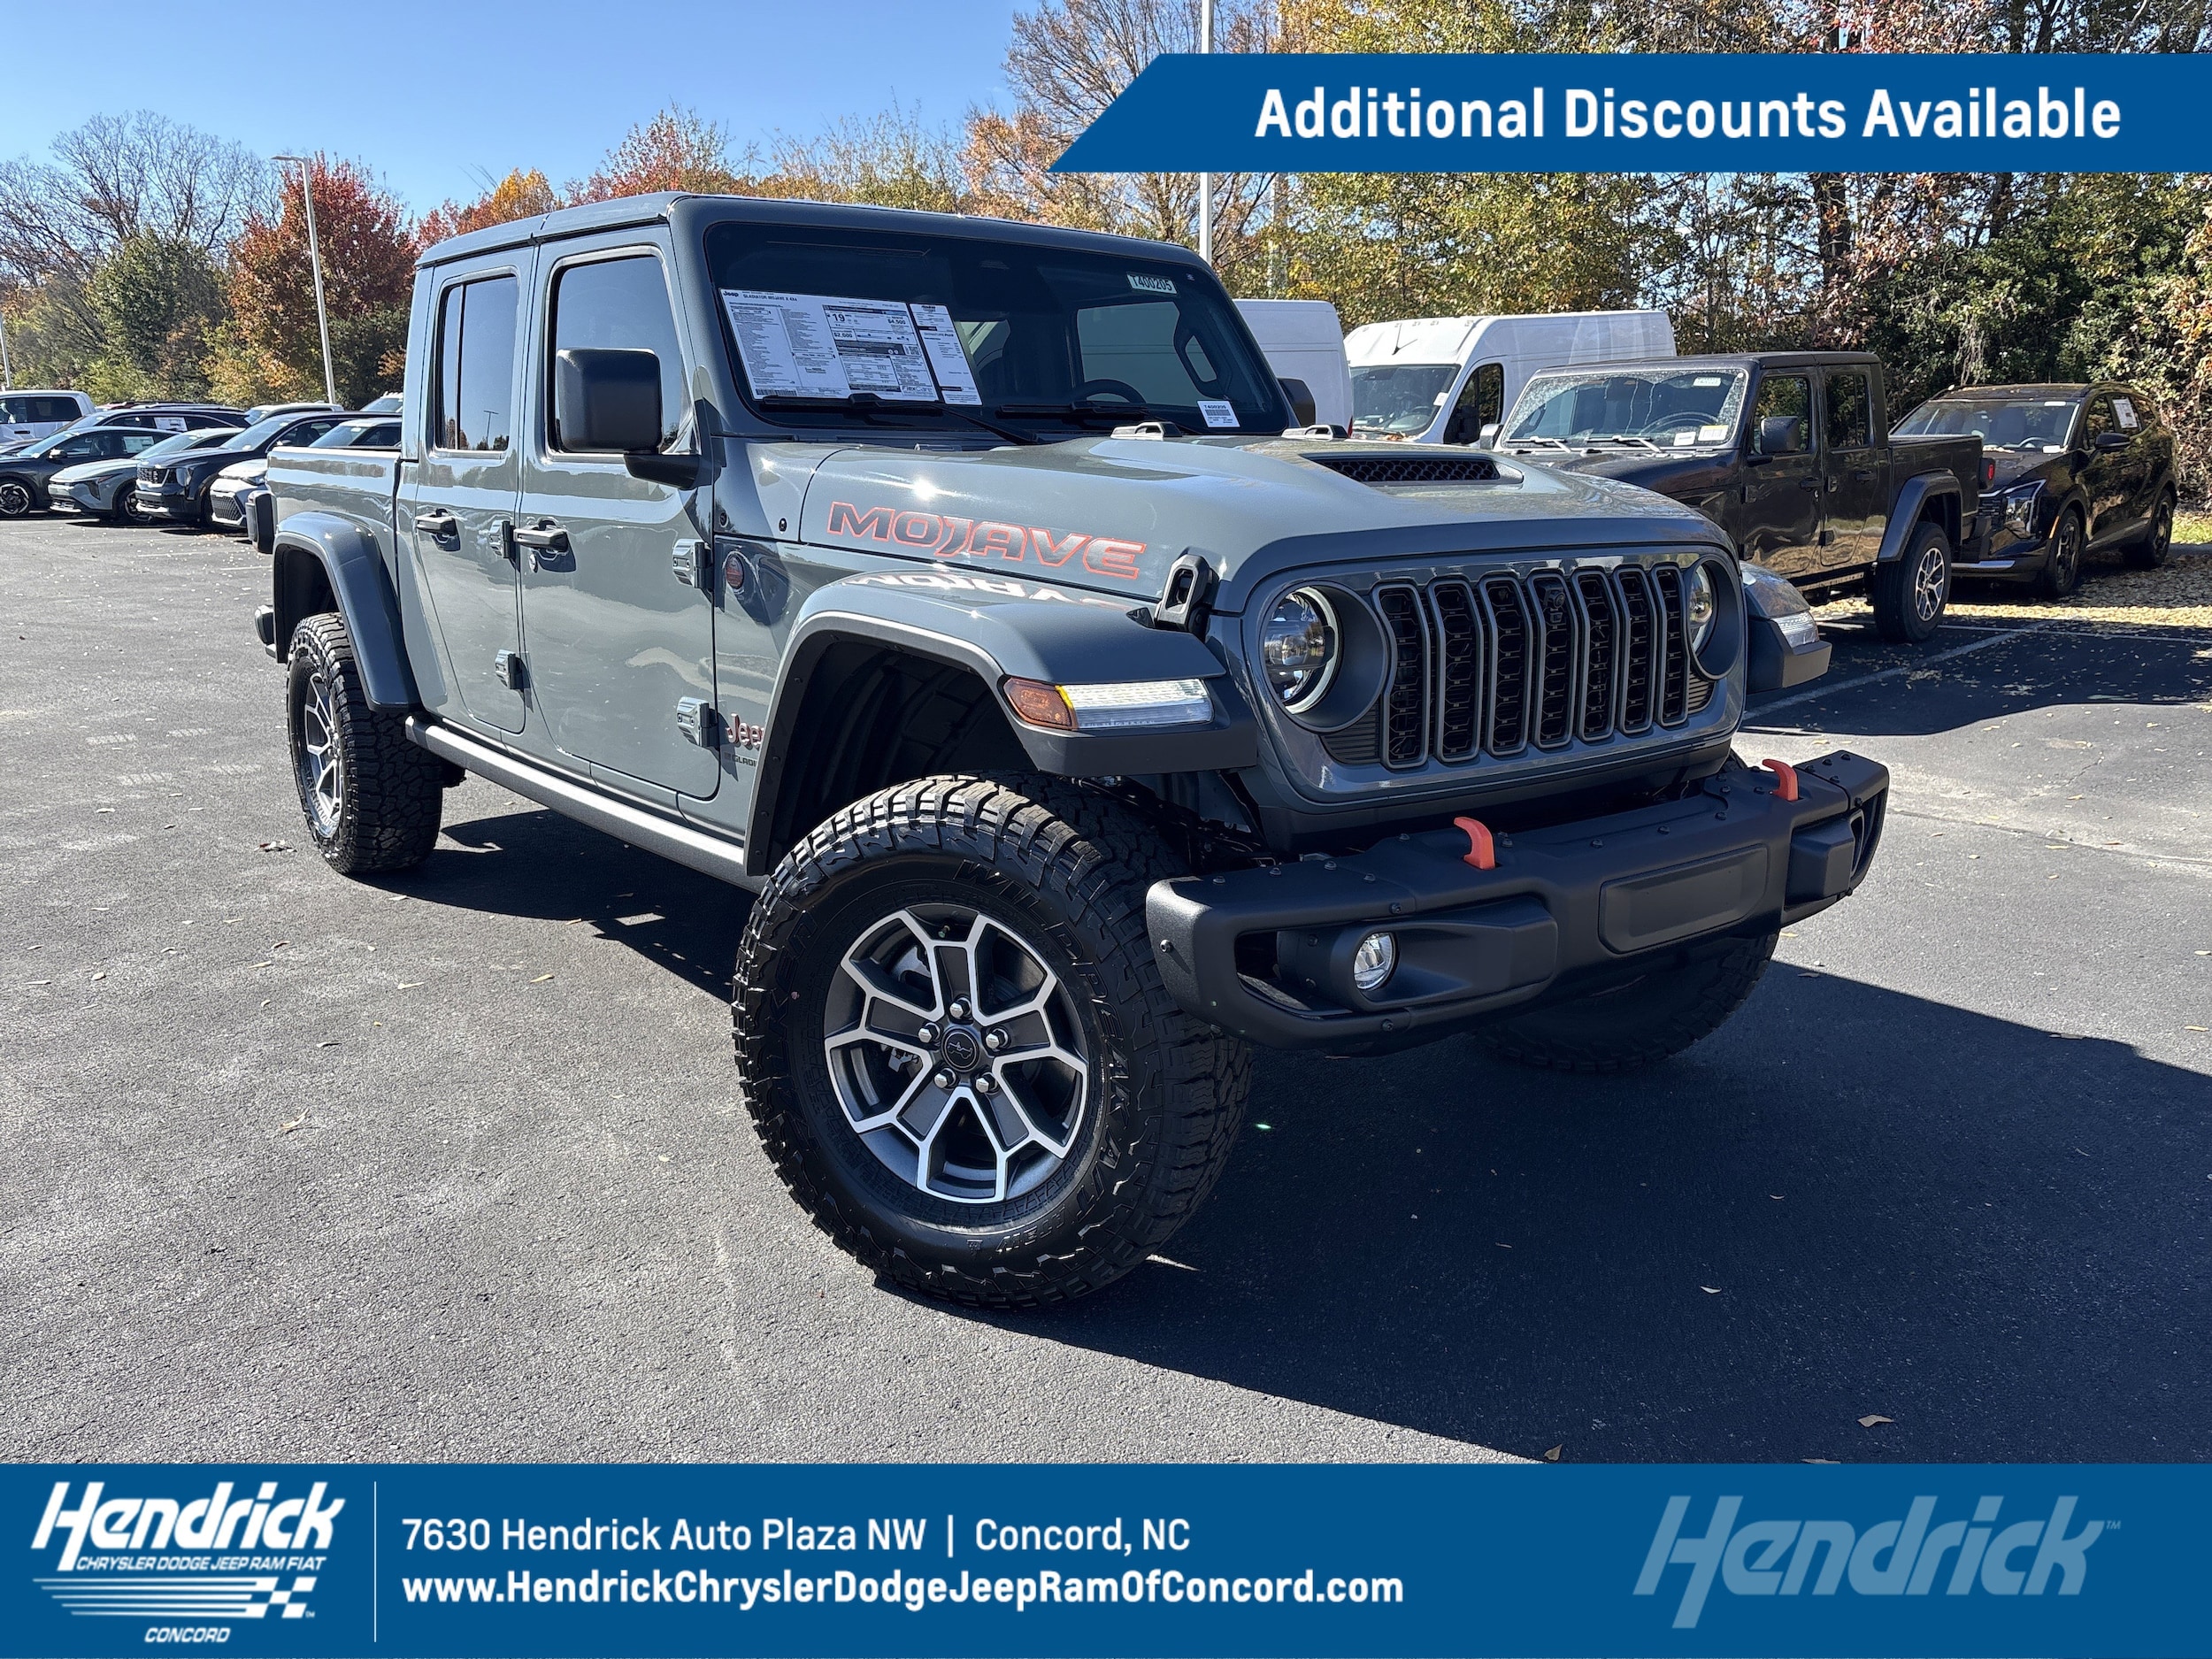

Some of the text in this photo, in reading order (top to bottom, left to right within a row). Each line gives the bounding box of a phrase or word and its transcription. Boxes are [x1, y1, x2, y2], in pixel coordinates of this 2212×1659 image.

[1130, 274, 1172, 291] T400205
[832, 313, 846, 322] 19
[827, 502, 1147, 580] MOJAVE
[733, 755, 757, 767] GLADI
[952, 858, 1132, 1129] WILDPEAK
